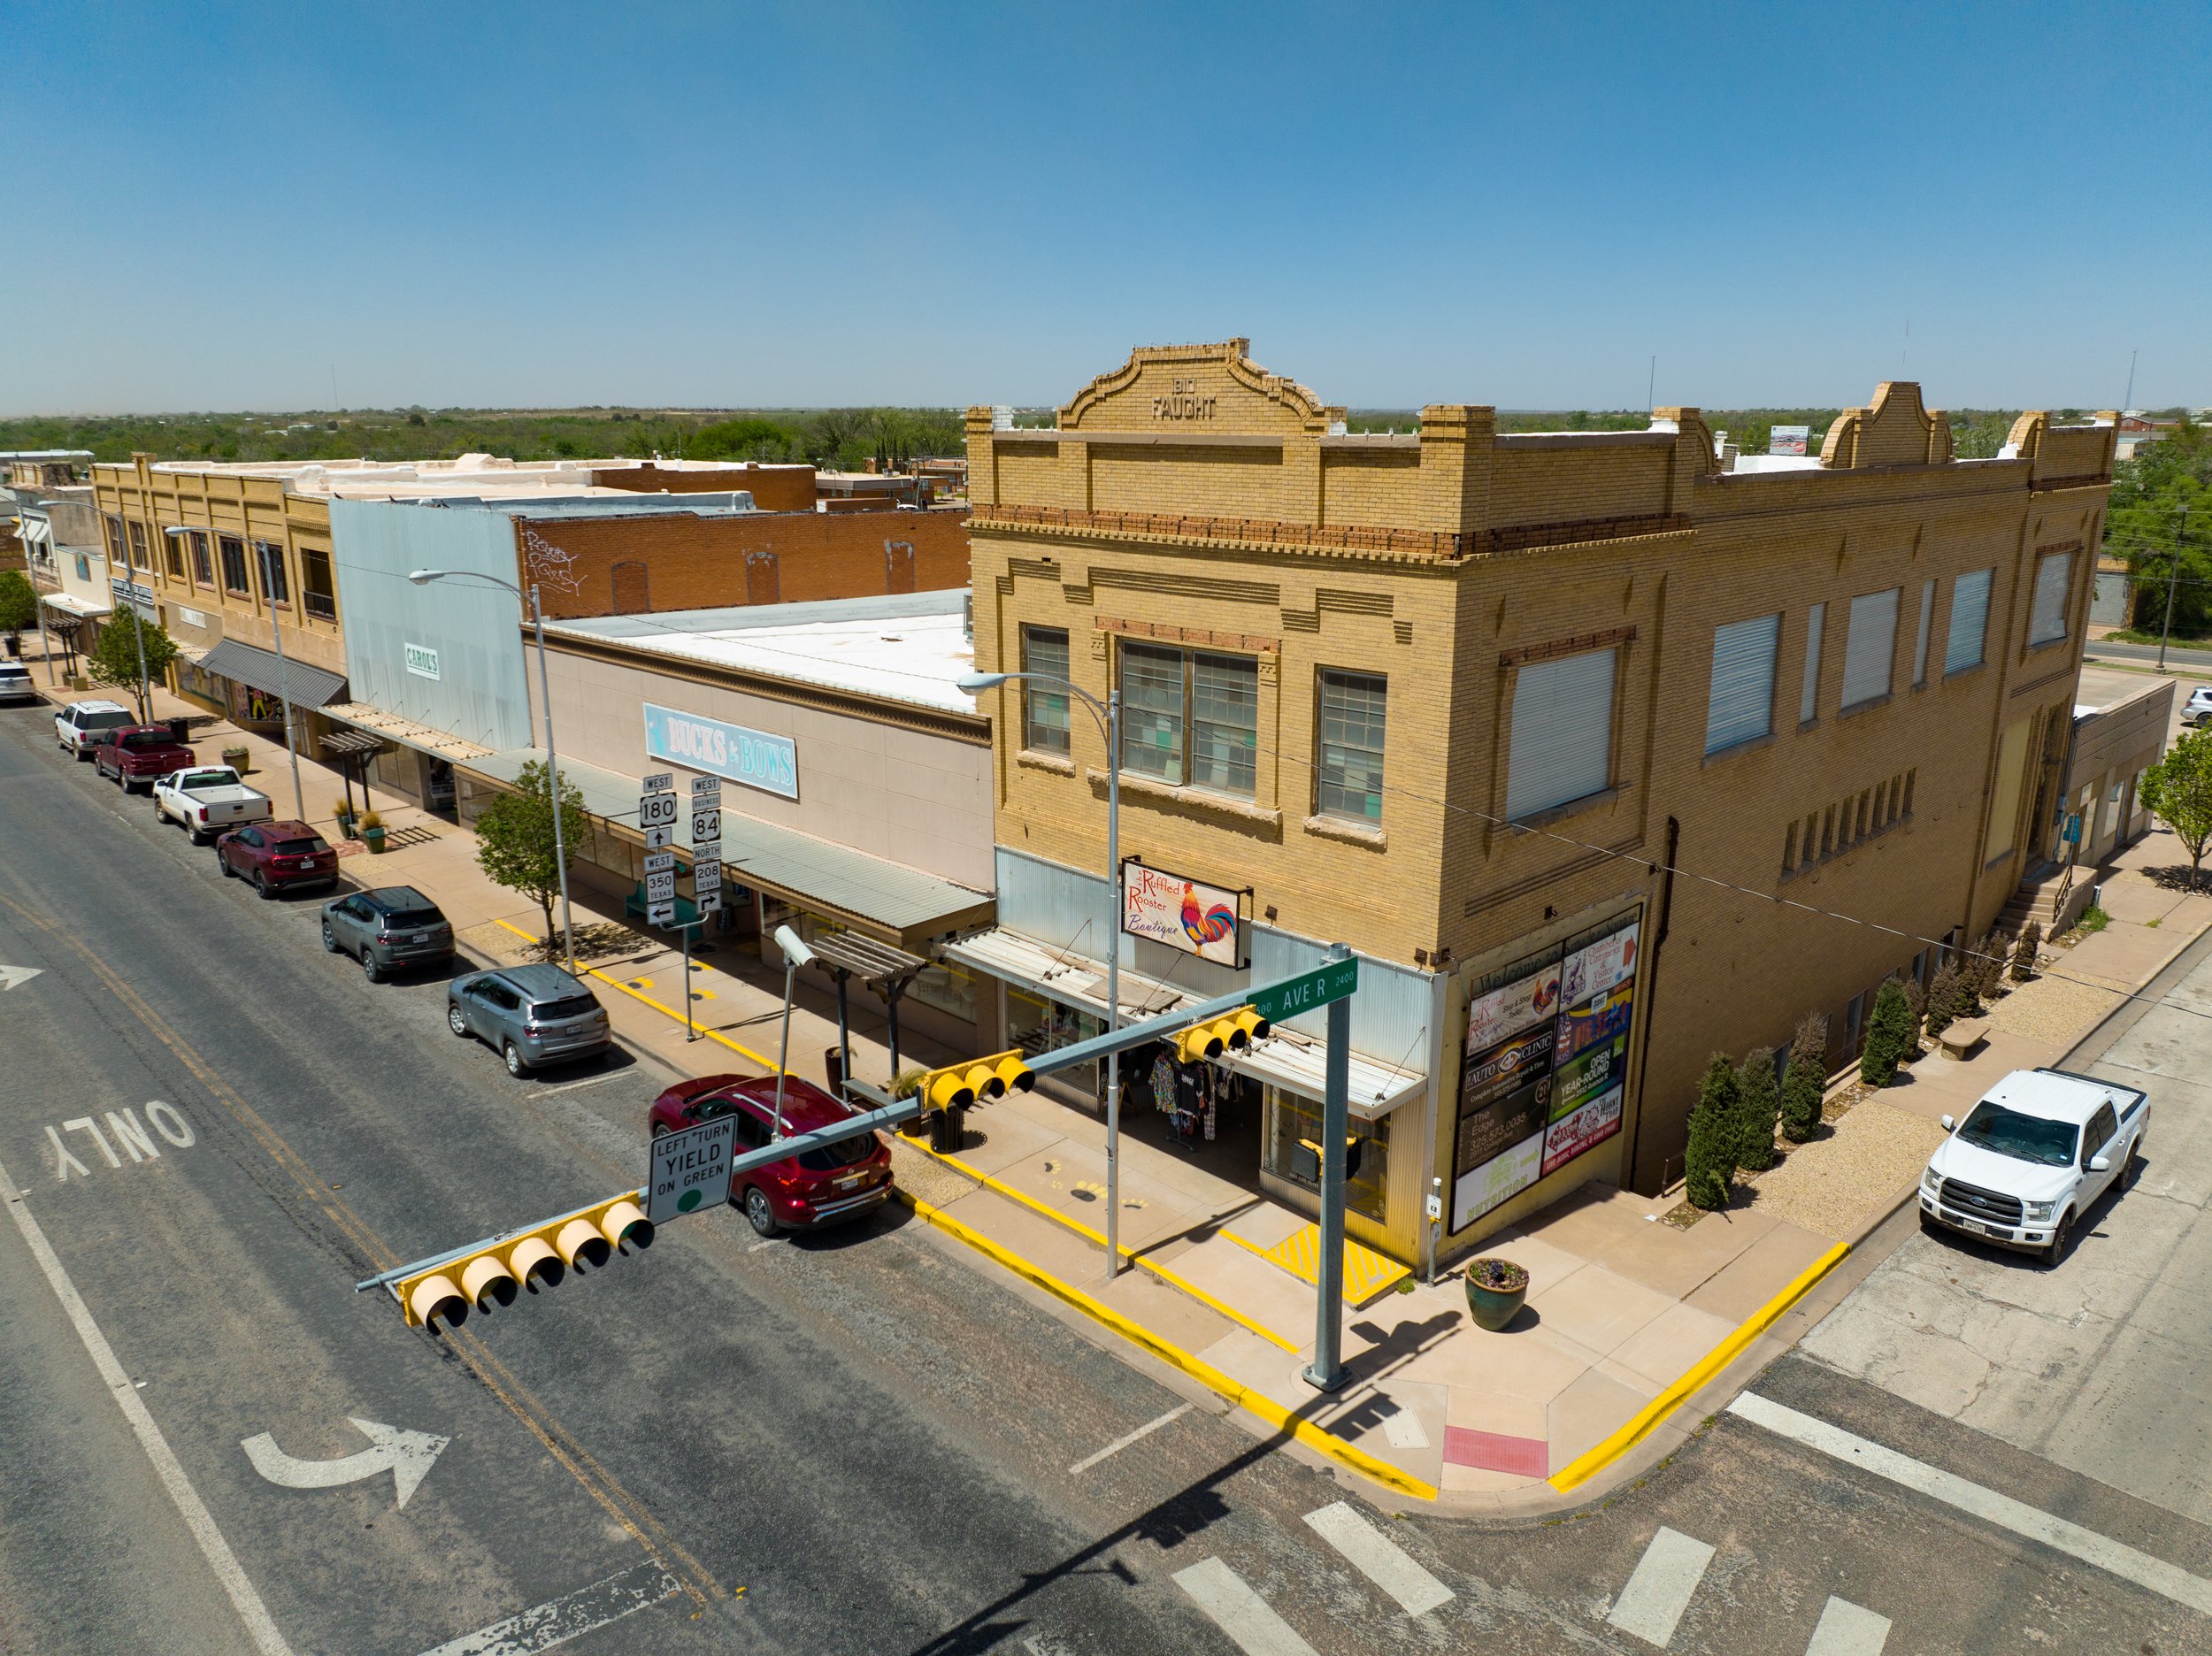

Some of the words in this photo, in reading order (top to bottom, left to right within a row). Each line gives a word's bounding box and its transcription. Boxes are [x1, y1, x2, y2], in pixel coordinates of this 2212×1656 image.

[1152, 395, 1217, 420] FAUGHT
[407, 648, 438, 671] CAROL'S
[667, 717, 727, 767] BUCKS
[740, 735, 794, 786] BOWS
[647, 777, 669, 789] WEST
[695, 778, 718, 790] WEST
[643, 800, 673, 820] 180
[694, 797, 719, 808] BUSINESS
[695, 816, 718, 835] 84
[648, 855, 671, 868] WEST
[695, 846, 720, 859] NORTH
[649, 875, 672, 888] 350
[697, 866, 718, 878] 208
[650, 889, 672, 900] TEXAS
[698, 878, 719, 889] TEXAS
[1142, 870, 1180, 897] Ruffled
[1128, 886, 1167, 913] Rooster
[1128, 914, 1178, 939] Boutique
[1256, 1001, 1271, 1015] 500
[1283, 984, 1310, 1010] AVE
[1317, 978, 1325, 997] R
[1335, 971, 1355, 986] 2400
[1592, 976, 1612, 991] Center
[1471, 1063, 1495, 1085] AUTO
[1522, 1035, 1551, 1059] CLINIC
[1590, 1048, 1610, 1070] OPEN
[1561, 1062, 1609, 1098] YEAR-ROUND
[1471, 1119, 1494, 1136] Edge
[1473, 1111, 1490, 1124] The
[44, 1100, 196, 1182] ONLY
[657, 1136, 688, 1157] LEFT
[698, 1123, 730, 1144] TURN
[666, 1144, 720, 1176] YIELD
[657, 1180, 675, 1196] ON
[684, 1163, 724, 1186] GREEN
[1467, 1174, 1528, 1222] NUTRITION
